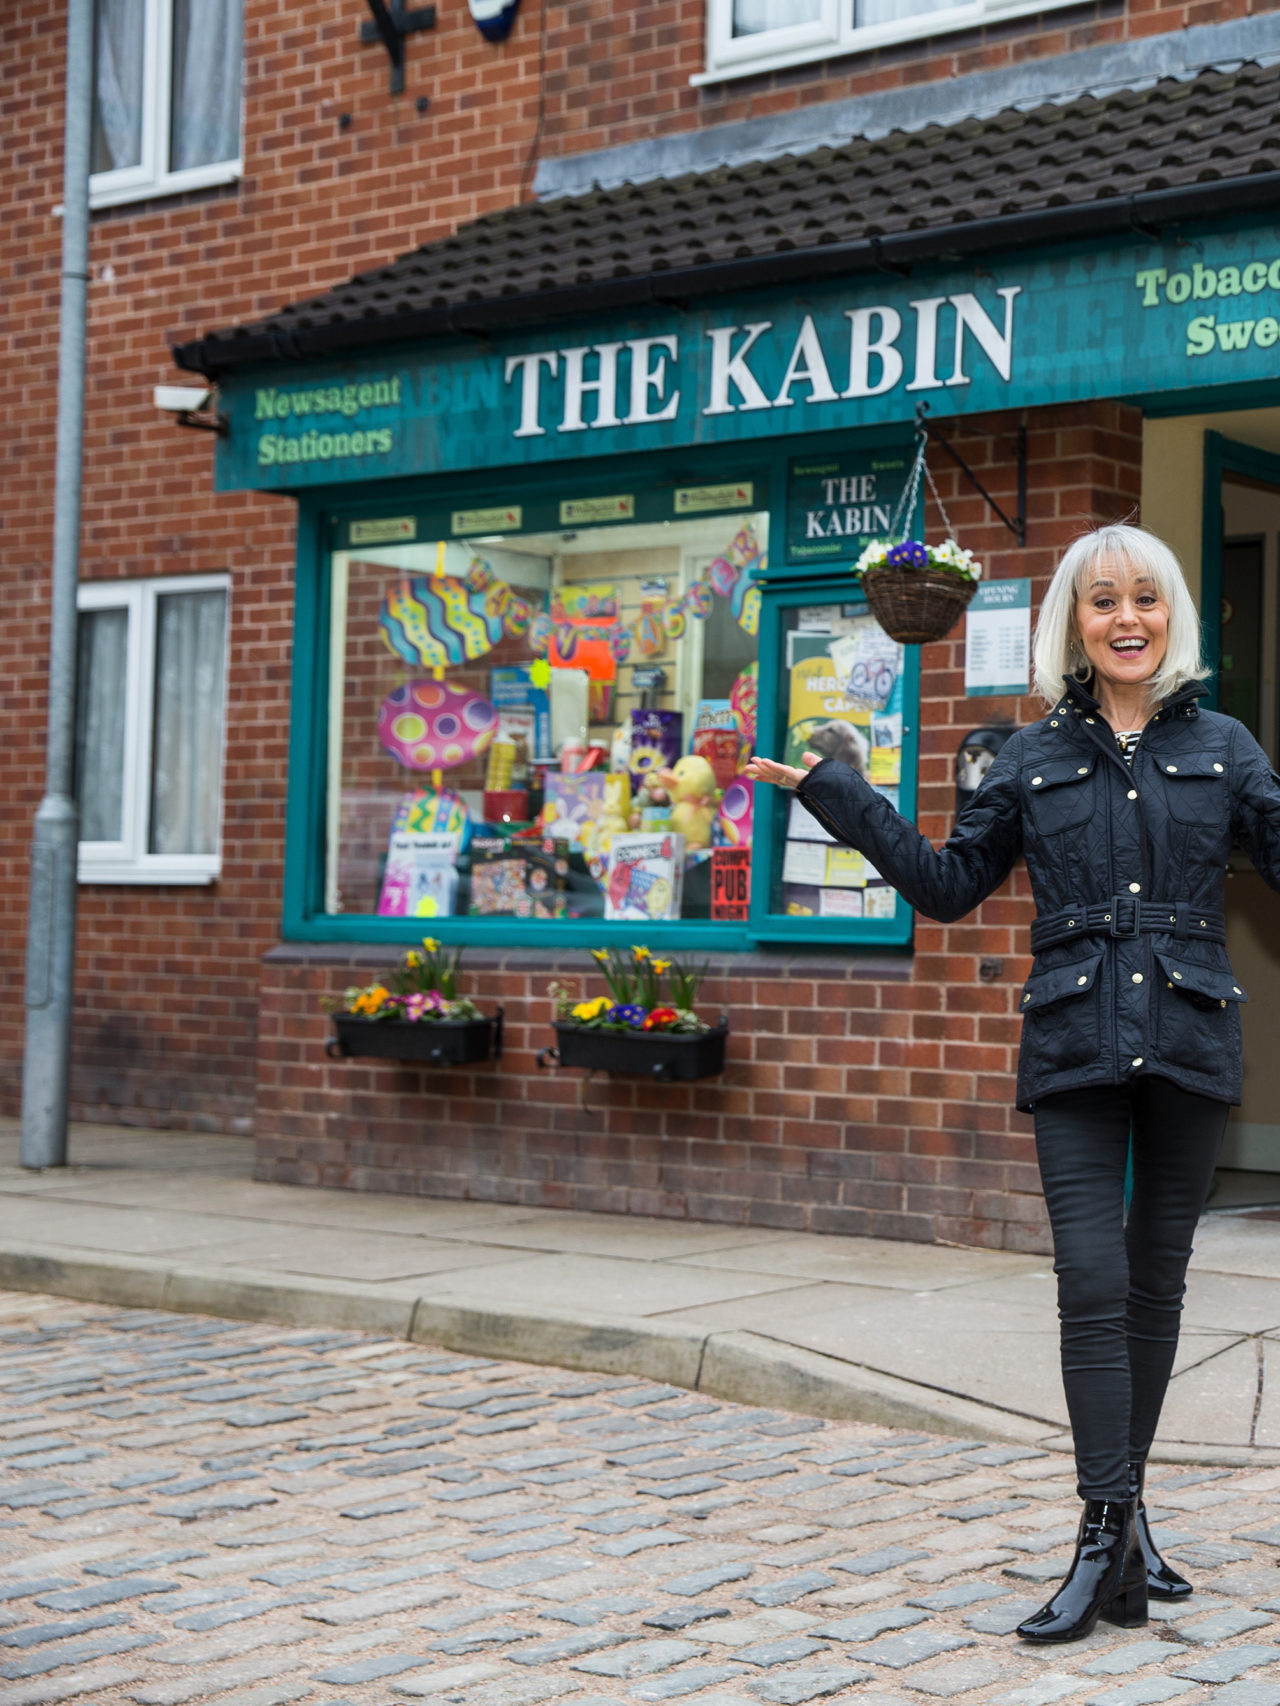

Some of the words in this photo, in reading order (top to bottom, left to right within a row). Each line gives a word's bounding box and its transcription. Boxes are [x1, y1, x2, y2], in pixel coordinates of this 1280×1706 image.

[504, 334, 681, 437] THE
[702, 286, 1022, 416] KABIN
[254, 375, 401, 421] Newsagent
[257, 426, 393, 467] Stationers
[820, 474, 877, 506] THE
[805, 504, 892, 539] KABIN
[714, 868, 747, 901] PUB
